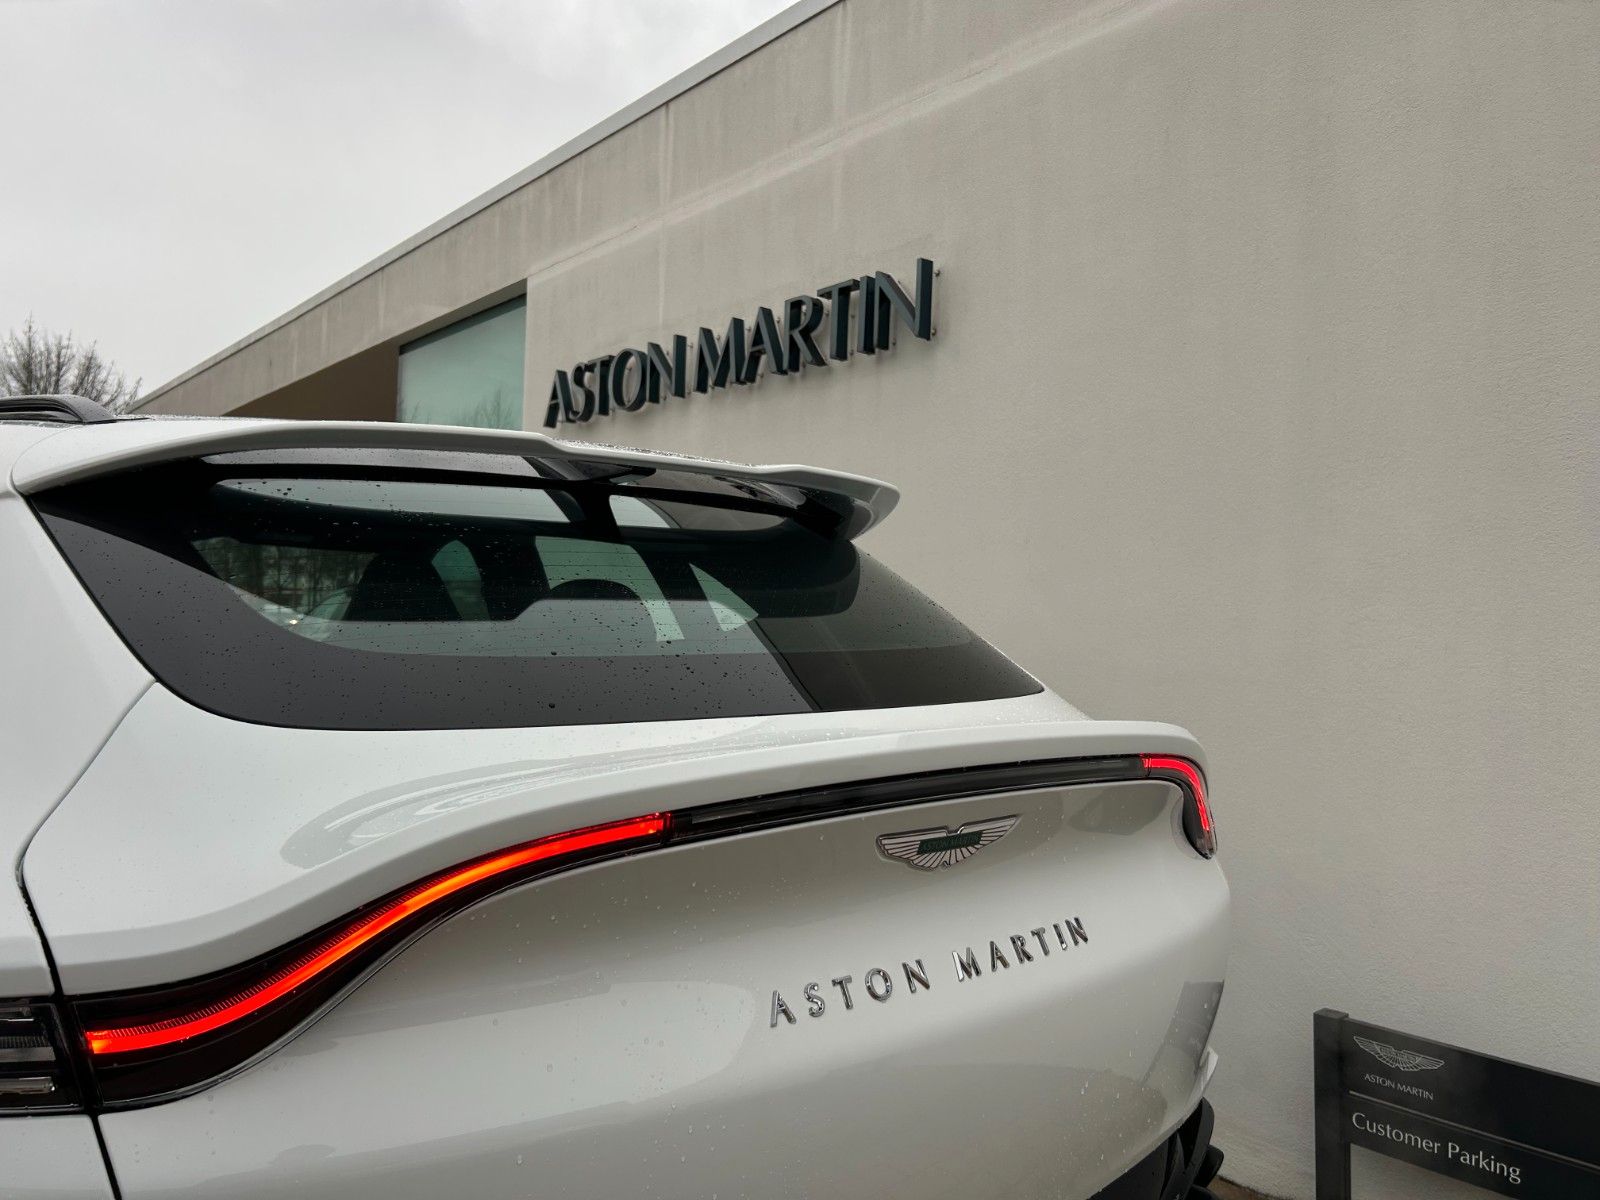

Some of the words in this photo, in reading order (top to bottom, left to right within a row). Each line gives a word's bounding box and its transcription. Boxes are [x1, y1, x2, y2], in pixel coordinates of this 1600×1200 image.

[543, 333, 688, 429] ASTON
[695, 257, 934, 394] MARTIN
[770, 959, 930, 1027] ASTON
[952, 917, 1089, 982] MARTIN
[1364, 1073, 1395, 1089] ASTON
[1397, 1083, 1434, 1100] MARTIN
[1352, 1112, 1441, 1154] Customer
[1447, 1142, 1521, 1184] Parking
